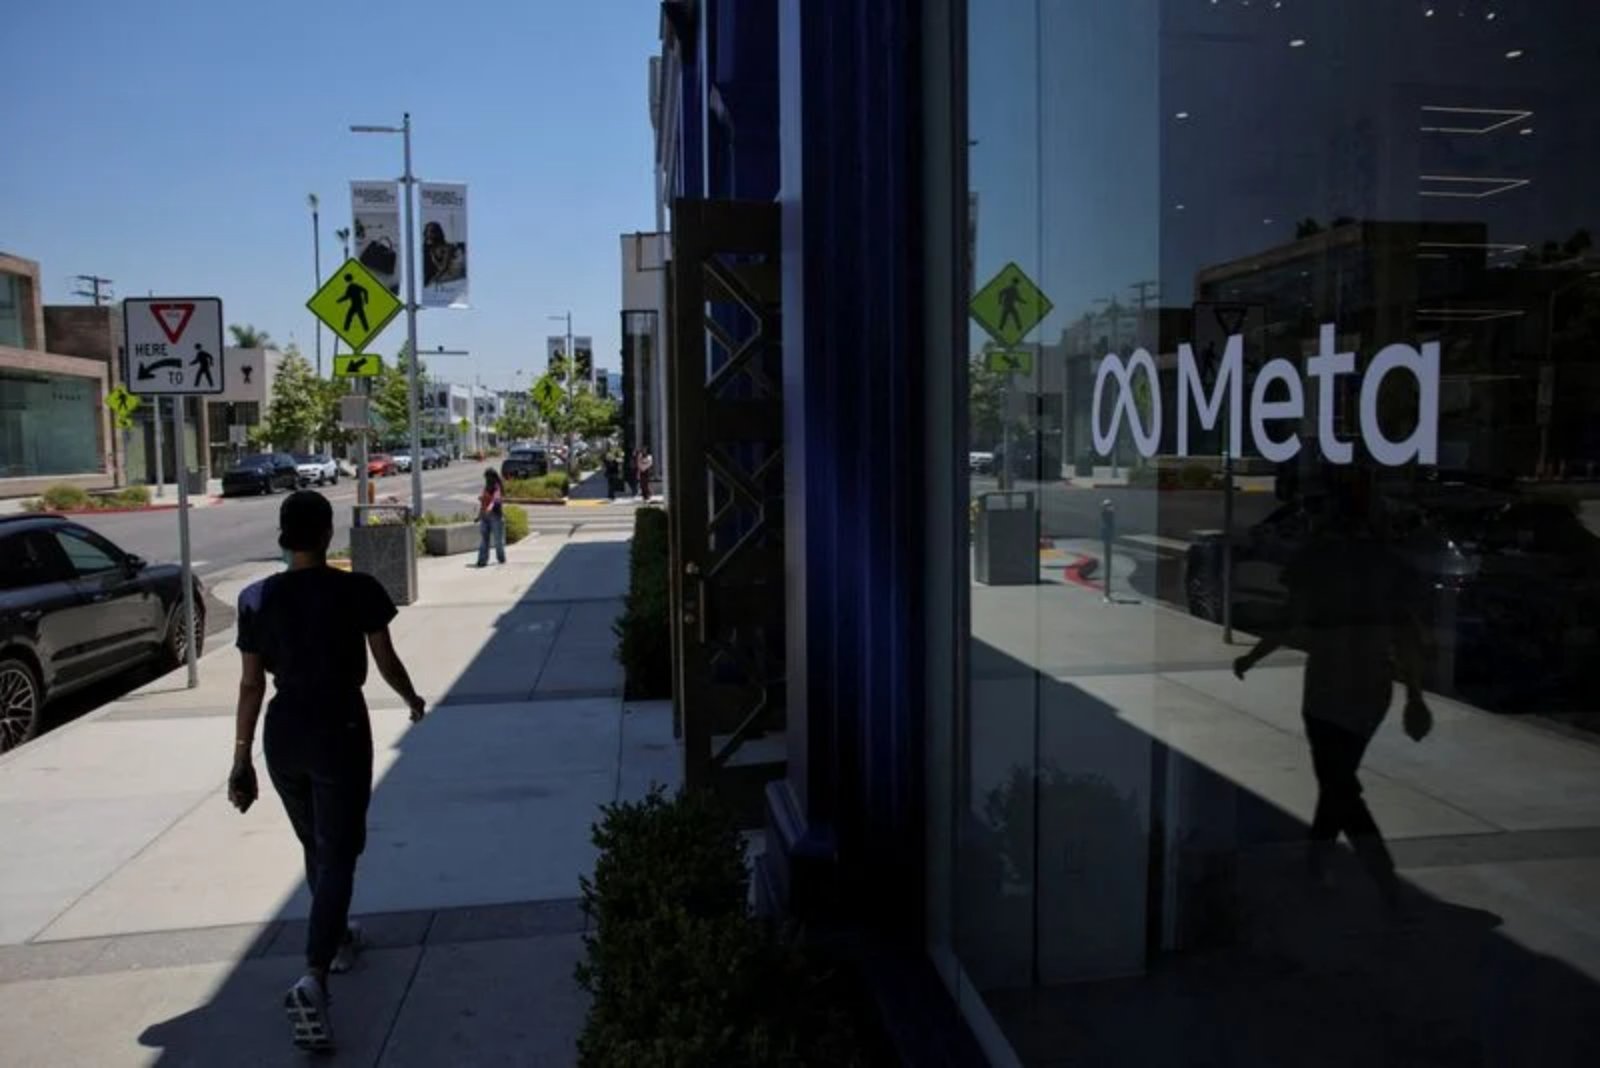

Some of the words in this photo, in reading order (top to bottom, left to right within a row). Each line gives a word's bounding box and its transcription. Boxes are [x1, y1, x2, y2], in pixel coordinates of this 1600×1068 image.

[135, 344, 168, 356] HERE
[168, 371, 183, 384] TO
[1177, 322, 1440, 466] Meta
